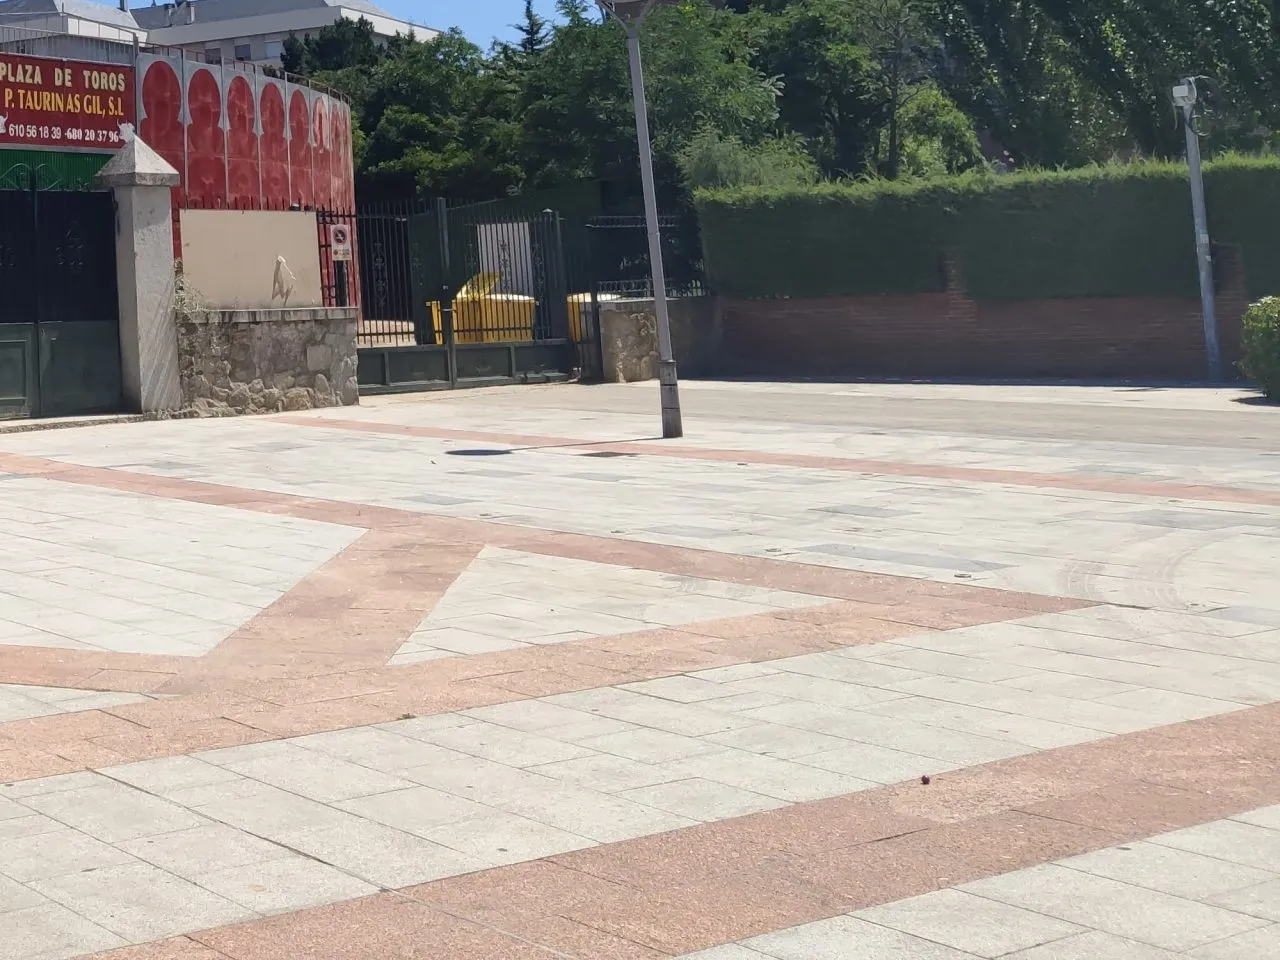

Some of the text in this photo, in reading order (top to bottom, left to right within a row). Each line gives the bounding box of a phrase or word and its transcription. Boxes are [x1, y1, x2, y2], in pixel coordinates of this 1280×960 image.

[54, 67, 72, 88] DE
[82, 70, 125, 92] TOROS
[4, 87, 15, 109] P.
[83, 94, 106, 119] GIL,
[108, 96, 124, 116] S.L
[8, 123, 25, 138] 610
[26, 125, 37, 138] 56
[38, 125, 49, 139] 18
[50, 126, 62, 140] 39
[84, 128, 96, 142] 20
[97, 130, 108, 143] 37
[108, 130, 119, 143] 96
